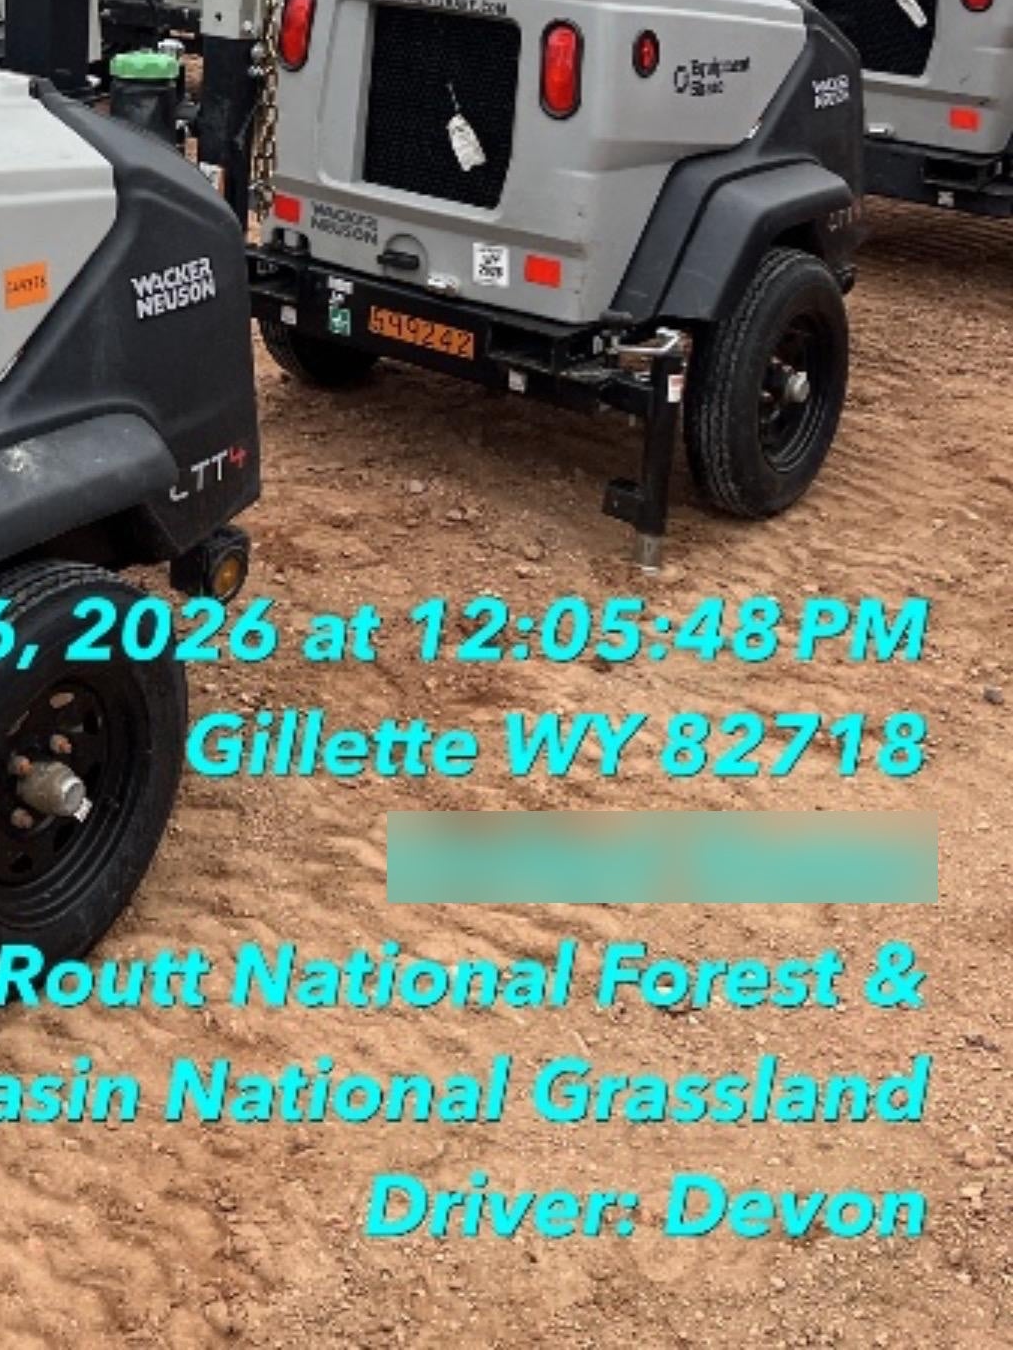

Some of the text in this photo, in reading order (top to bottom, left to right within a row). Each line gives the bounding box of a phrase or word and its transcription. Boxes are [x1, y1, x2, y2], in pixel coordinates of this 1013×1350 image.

[130, 256, 212, 297] WACKER
[136, 279, 216, 319] NEUSON
[169, 449, 246, 502] LTT4
